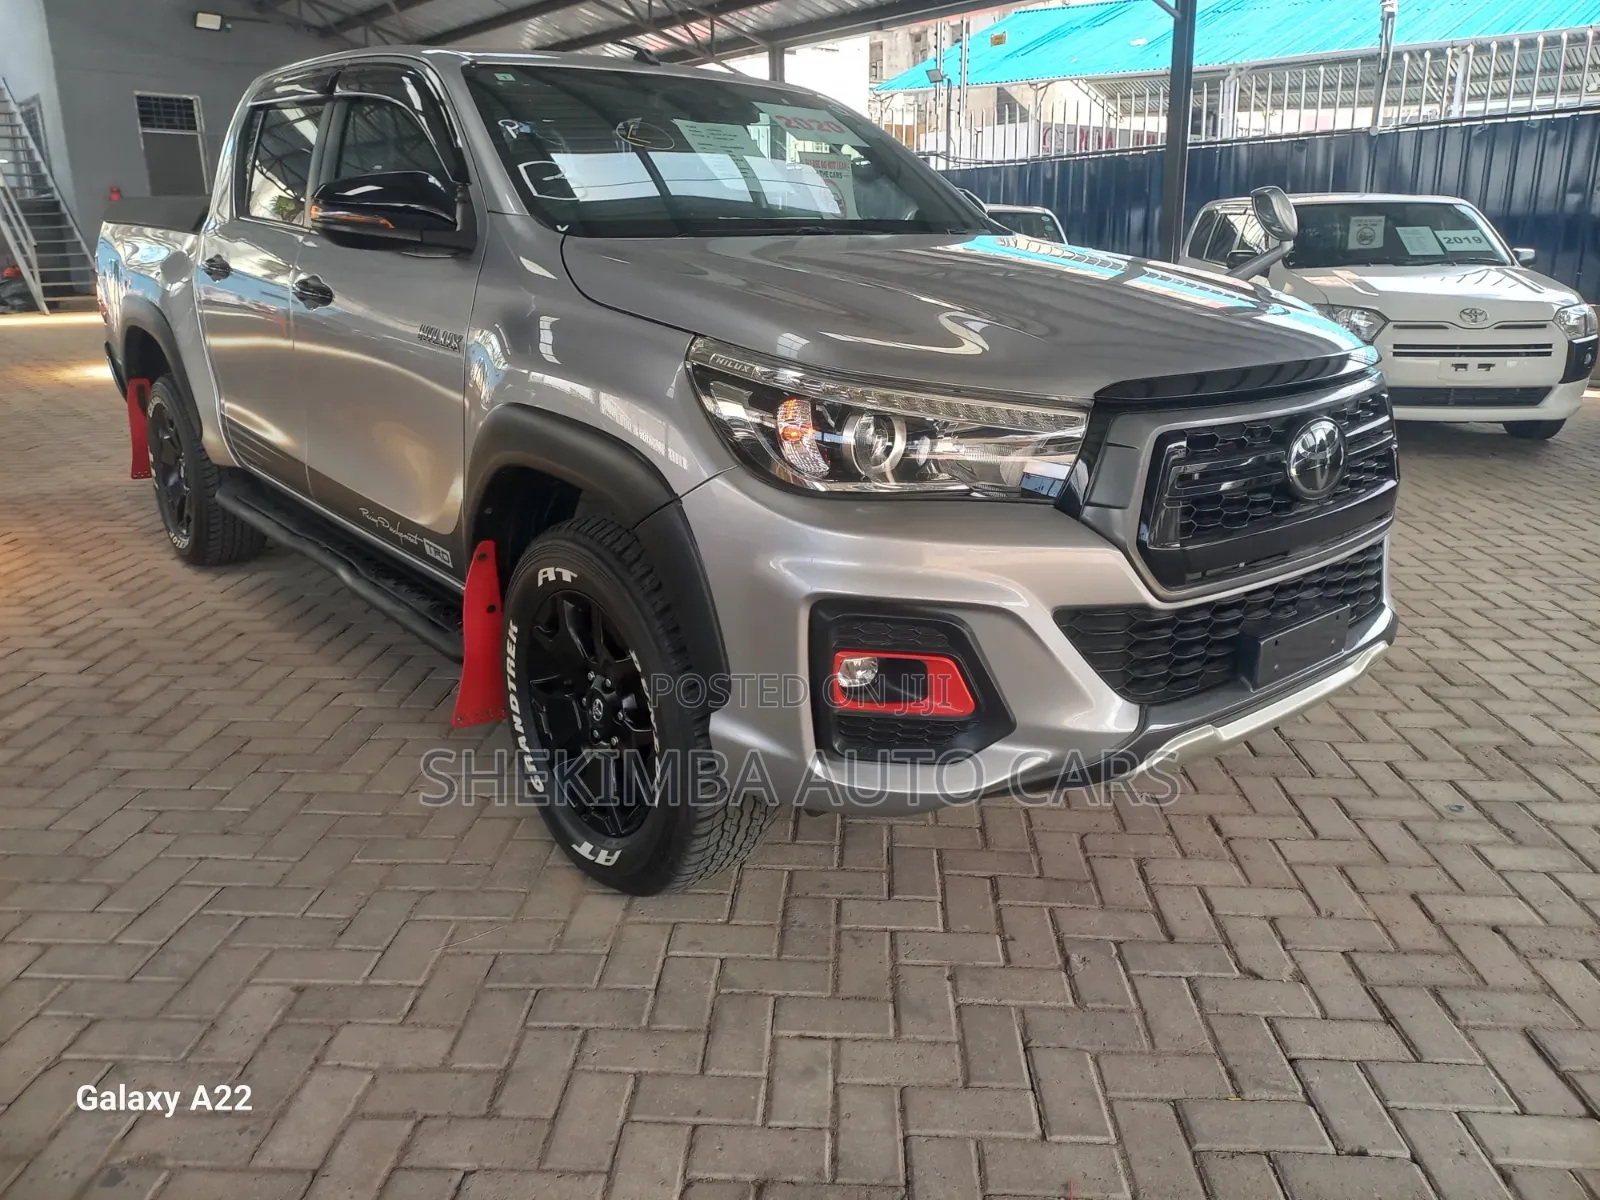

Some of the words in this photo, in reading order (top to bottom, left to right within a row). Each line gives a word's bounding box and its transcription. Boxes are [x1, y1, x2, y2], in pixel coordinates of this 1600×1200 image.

[775, 115, 846, 134] 2020
[1443, 236, 1483, 245] 2019
[417, 324, 464, 353] HILUX
[715, 356, 750, 374] HILUX
[537, 567, 578, 587] AT
[506, 619, 545, 793] GRANDTREK
[571, 841, 622, 866] AT
